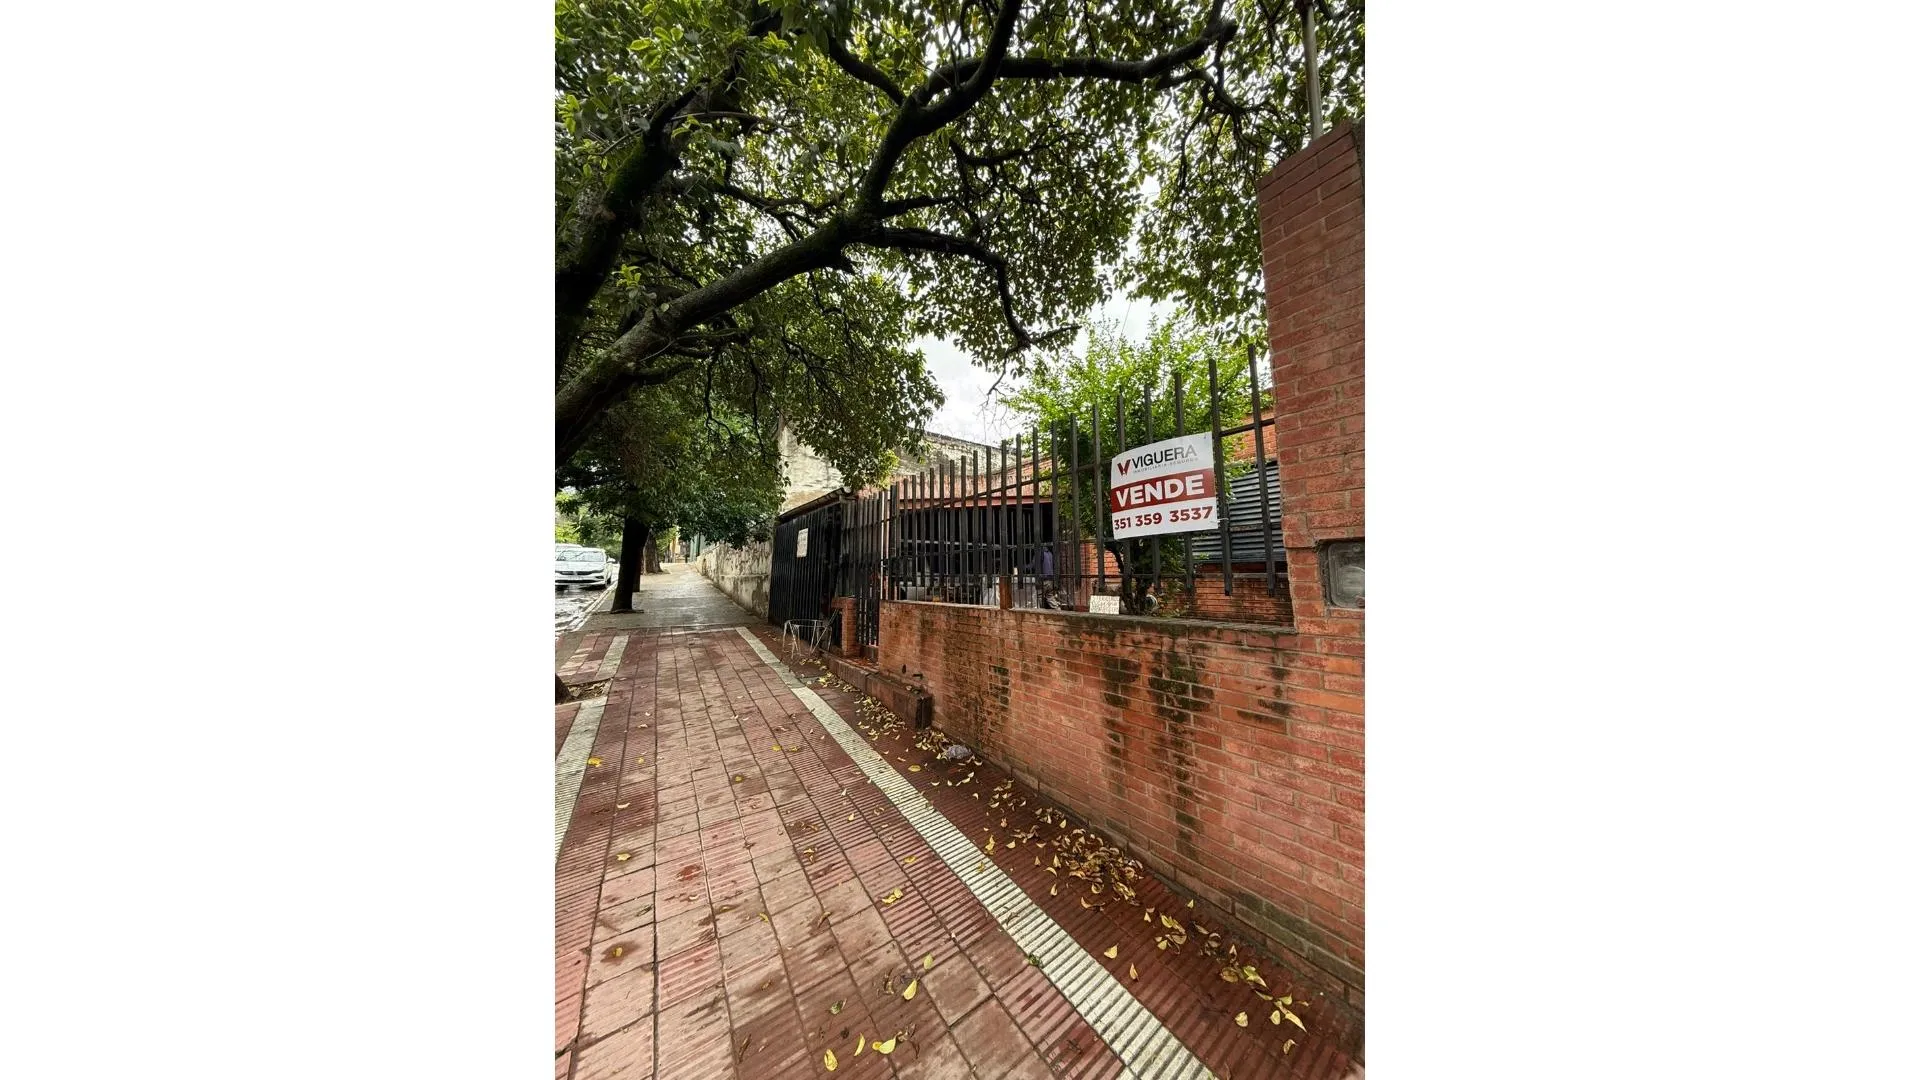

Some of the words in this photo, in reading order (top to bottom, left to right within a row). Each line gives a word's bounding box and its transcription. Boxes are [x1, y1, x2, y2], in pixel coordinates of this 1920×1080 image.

[1132, 445, 1197, 468] VIGUERA
[1116, 474, 1204, 507] VENDE
[1114, 517, 1132, 530] 351
[1135, 512, 1162, 527] 359
[1169, 506, 1213, 522] 3537
